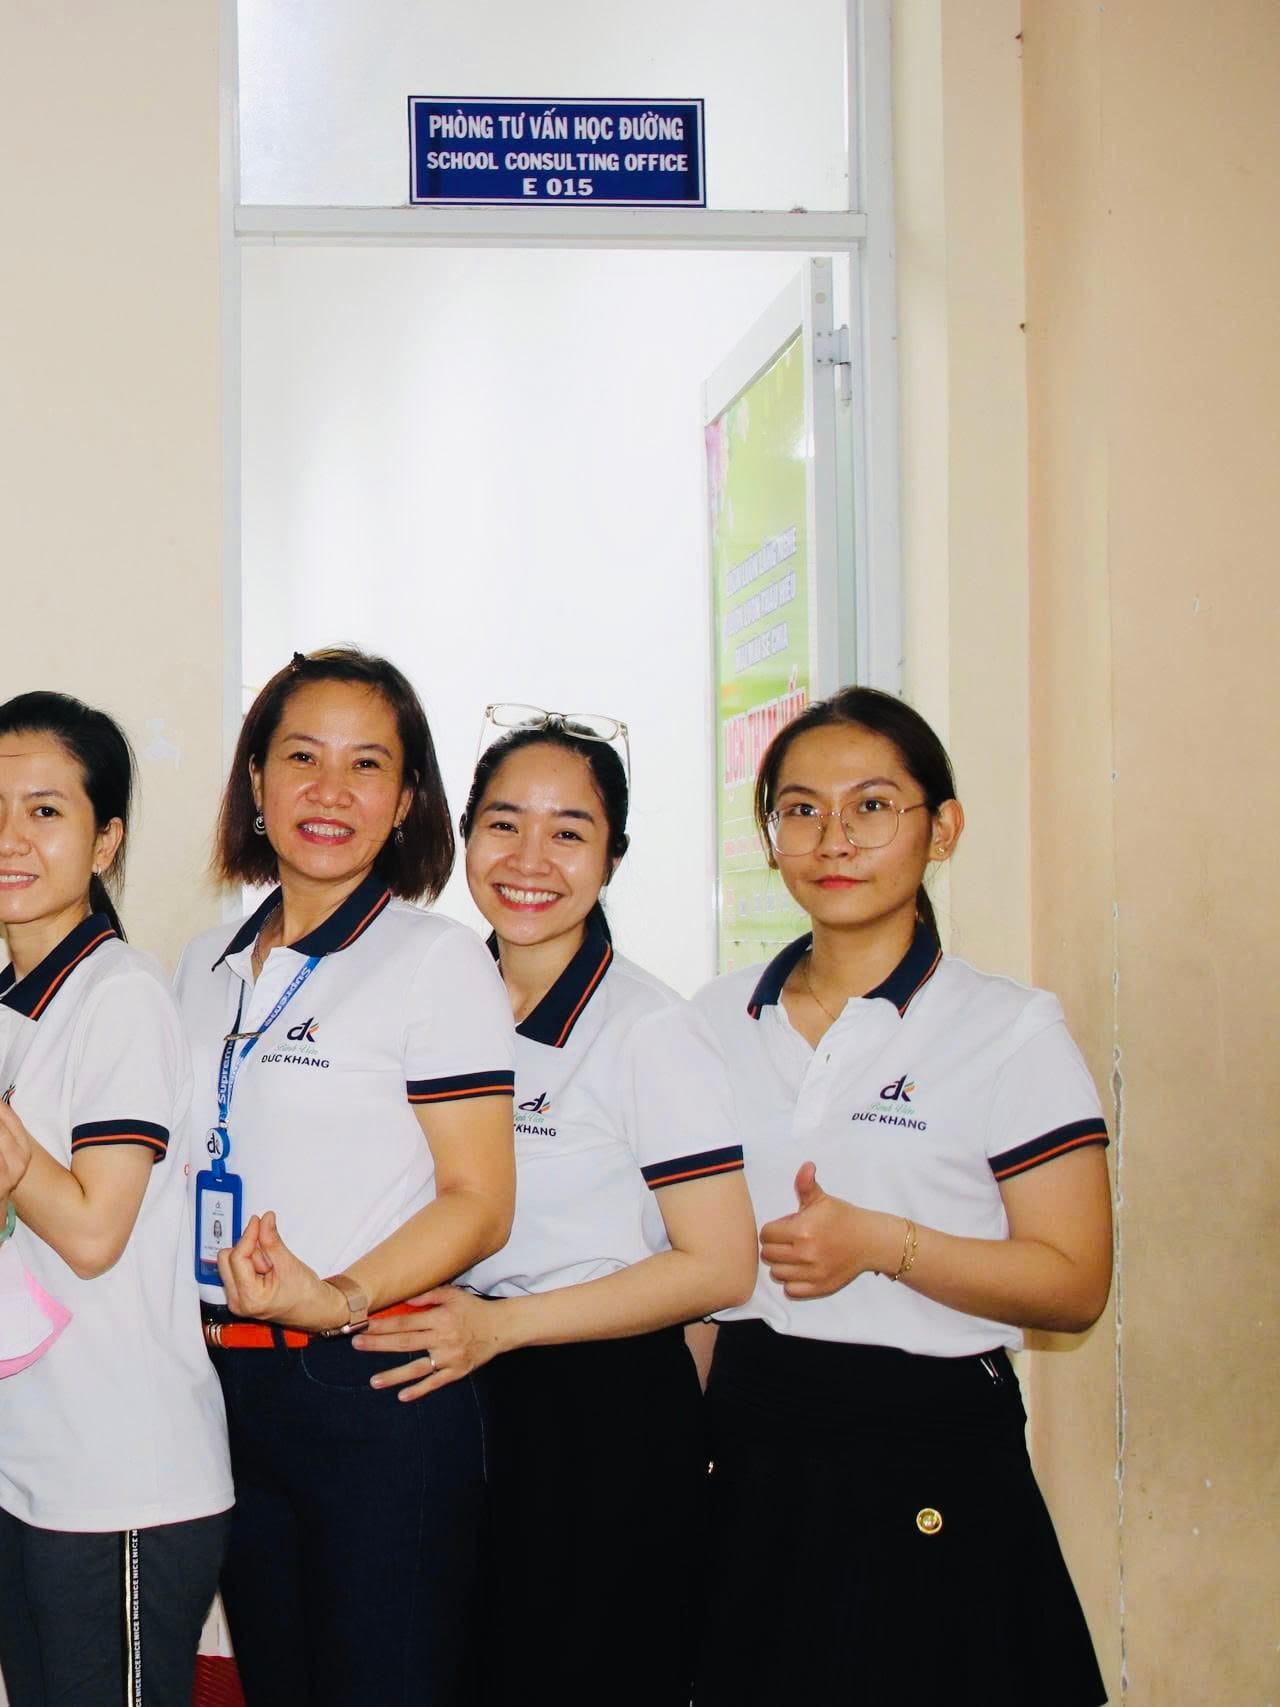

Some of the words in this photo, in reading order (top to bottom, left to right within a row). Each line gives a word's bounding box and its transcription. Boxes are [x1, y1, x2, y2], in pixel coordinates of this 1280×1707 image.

[429, 110, 493, 139] PHÒNG
[498, 112, 525, 139] TƯ
[529, 108, 568, 140] VẤN
[574, 116, 613, 144] HỌC
[619, 111, 684, 141] ĐƯỜNG
[427, 151, 498, 170] SCHOOL
[505, 152, 620, 172] CONSULTING
[624, 153, 688, 172] OFFICE
[523, 178, 538, 195] E
[546, 178, 593, 196] 015
[283, 1055, 330, 1069] KHANG
[879, 1114, 927, 1132] KHANG
